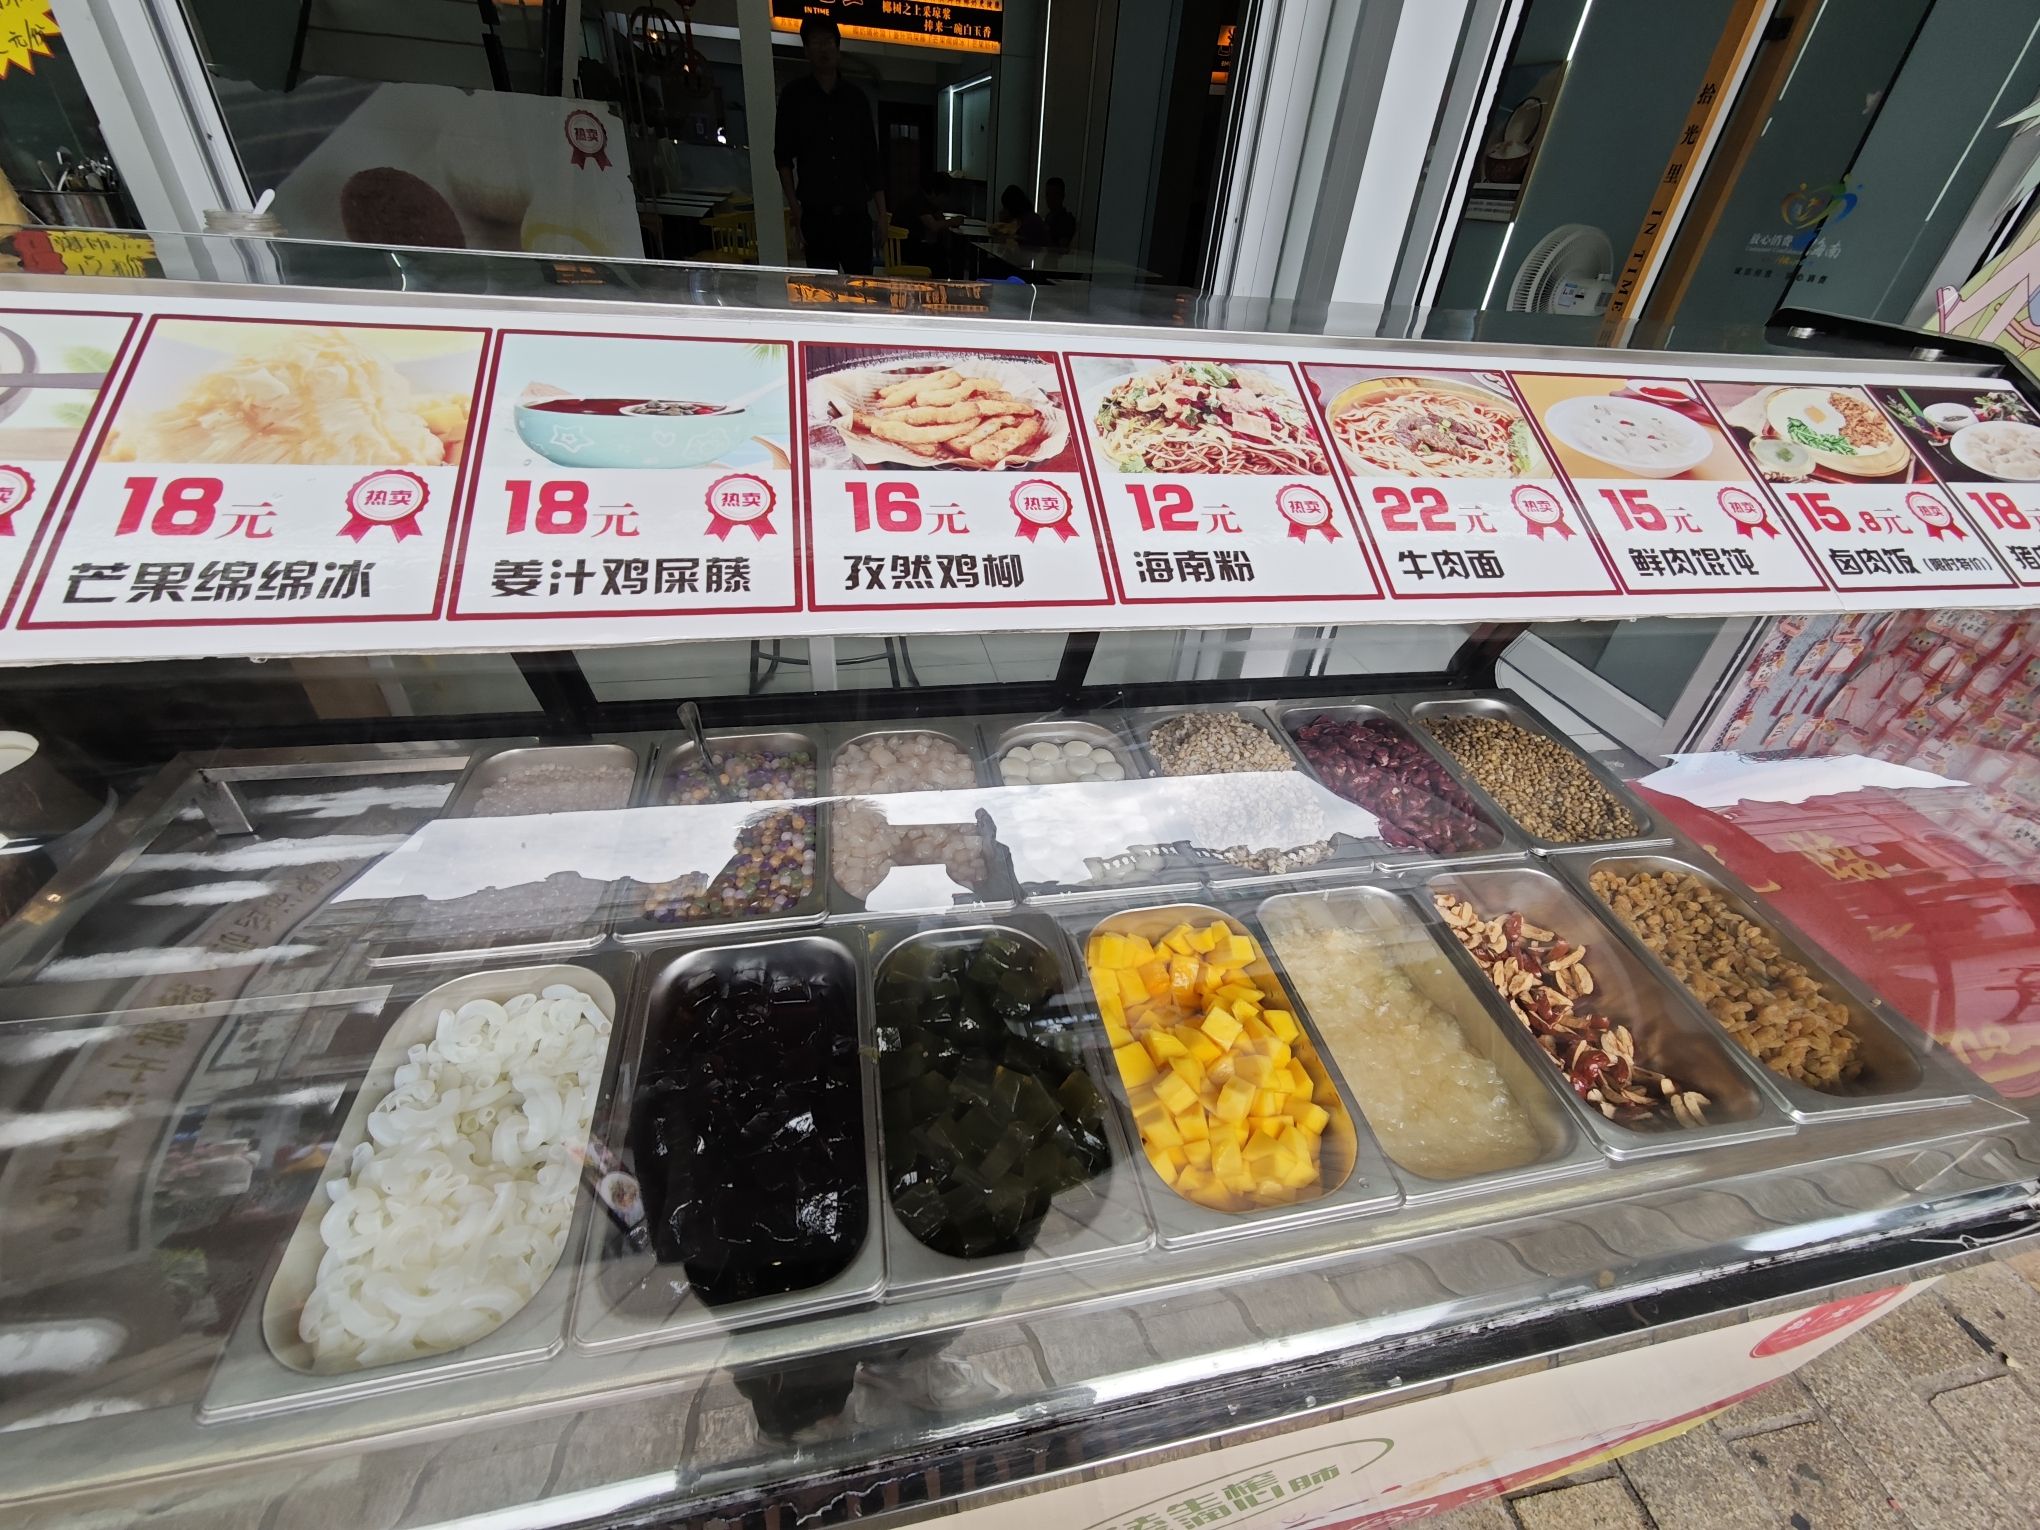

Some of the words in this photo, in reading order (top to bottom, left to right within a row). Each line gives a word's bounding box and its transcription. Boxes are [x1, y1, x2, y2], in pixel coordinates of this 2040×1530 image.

[1663, 83, 1716, 184] 拾光里
[1644, 209, 1663, 235] IN
[1611, 249, 1645, 312] TIME
[114, 476, 278, 540] 18元
[363, 489, 412, 506] 热卖
[504, 479, 641, 538] 18元
[721, 492, 761, 508] 热卖
[844, 481, 970, 536] 16元
[1024, 496, 1060, 511] 热卖
[1125, 483, 1243, 535] 12元
[1288, 500, 1322, 514] 热卖
[1372, 486, 1498, 533] 22元
[1598, 488, 1704, 533] 15元
[843, 553, 1025, 591] 孜然鸡柳
[1133, 550, 1256, 584] 海南粉
[1398, 549, 1505, 581] 牛肉面
[1628, 547, 1760, 577] 鲜肉馄饨
[1828, 548, 1922, 576] 卤肉饭
[2005, 545, 2040, 570] 猪
[62, 559, 377, 604] 芒果绵绵冰
[490, 556, 752, 598] 姜汁鸡屎藤
